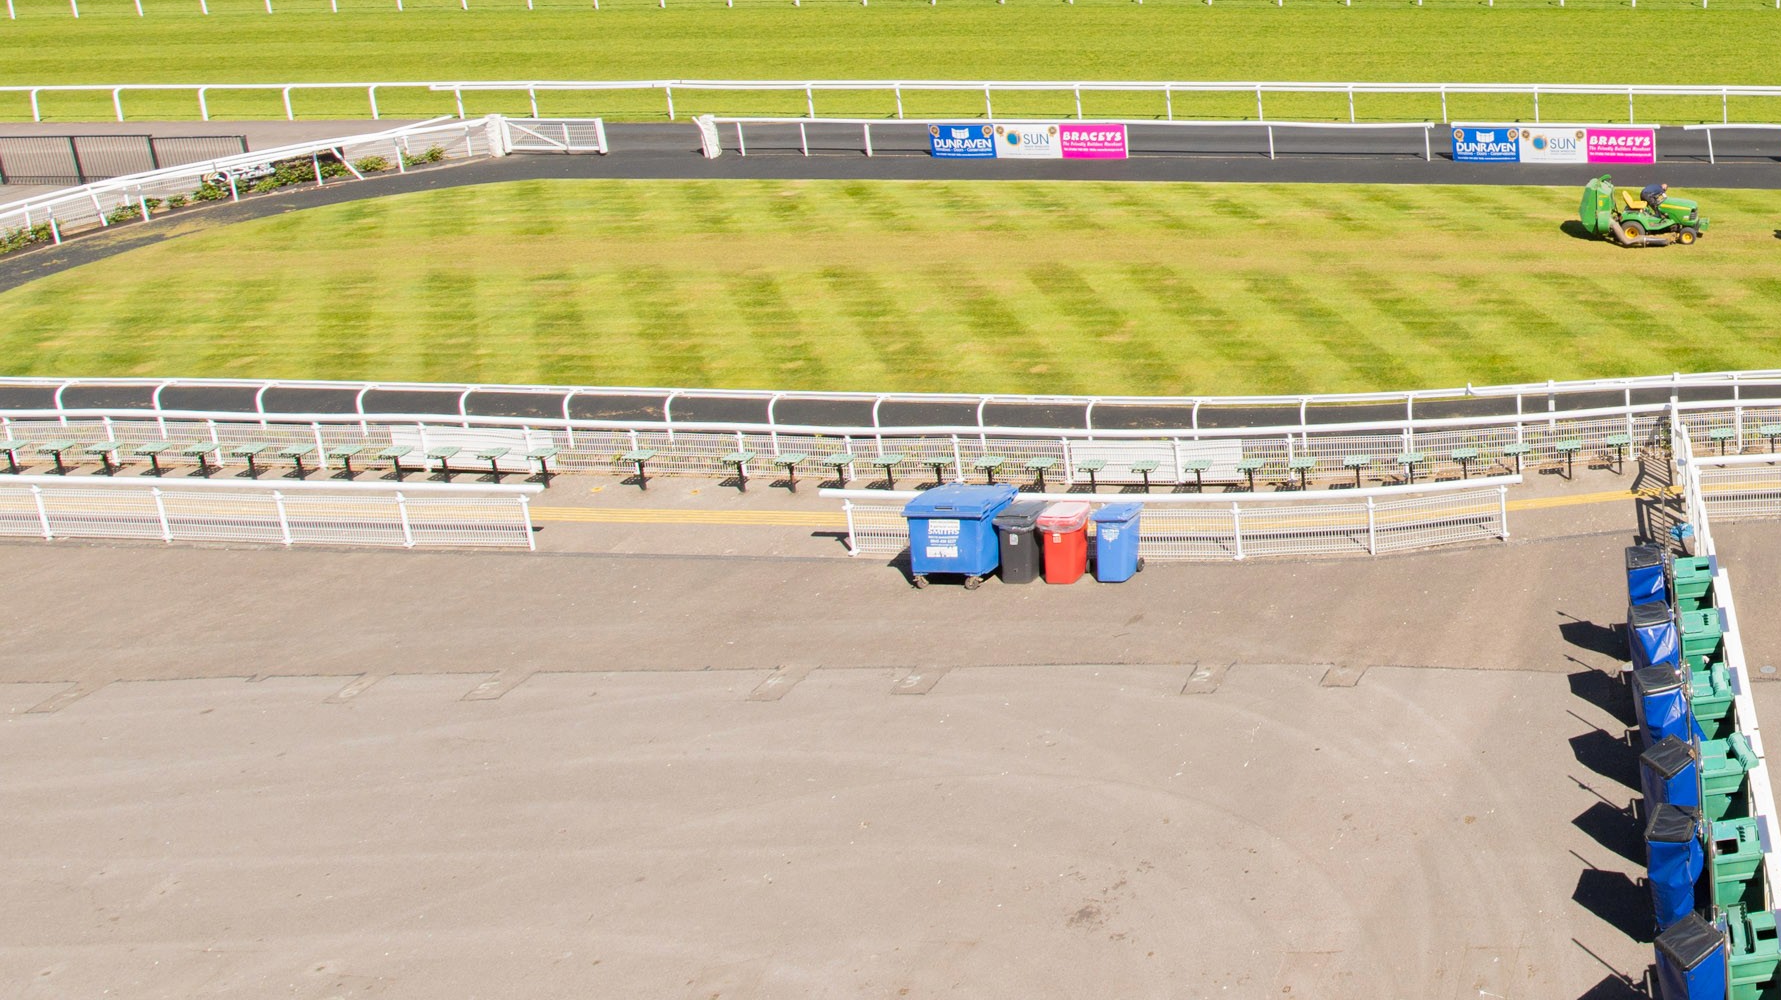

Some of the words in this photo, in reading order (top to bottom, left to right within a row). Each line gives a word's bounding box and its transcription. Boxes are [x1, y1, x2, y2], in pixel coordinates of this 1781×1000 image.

[1023, 133, 1049, 144] SUN
[1063, 131, 1122, 141] BRACEYS
[1589, 136, 1650, 146] BRACEYS
[933, 138, 992, 148] DUNRAVEN
[1456, 142, 1516, 152] DUNRAVEN
[1550, 138, 1576, 149] SUN
